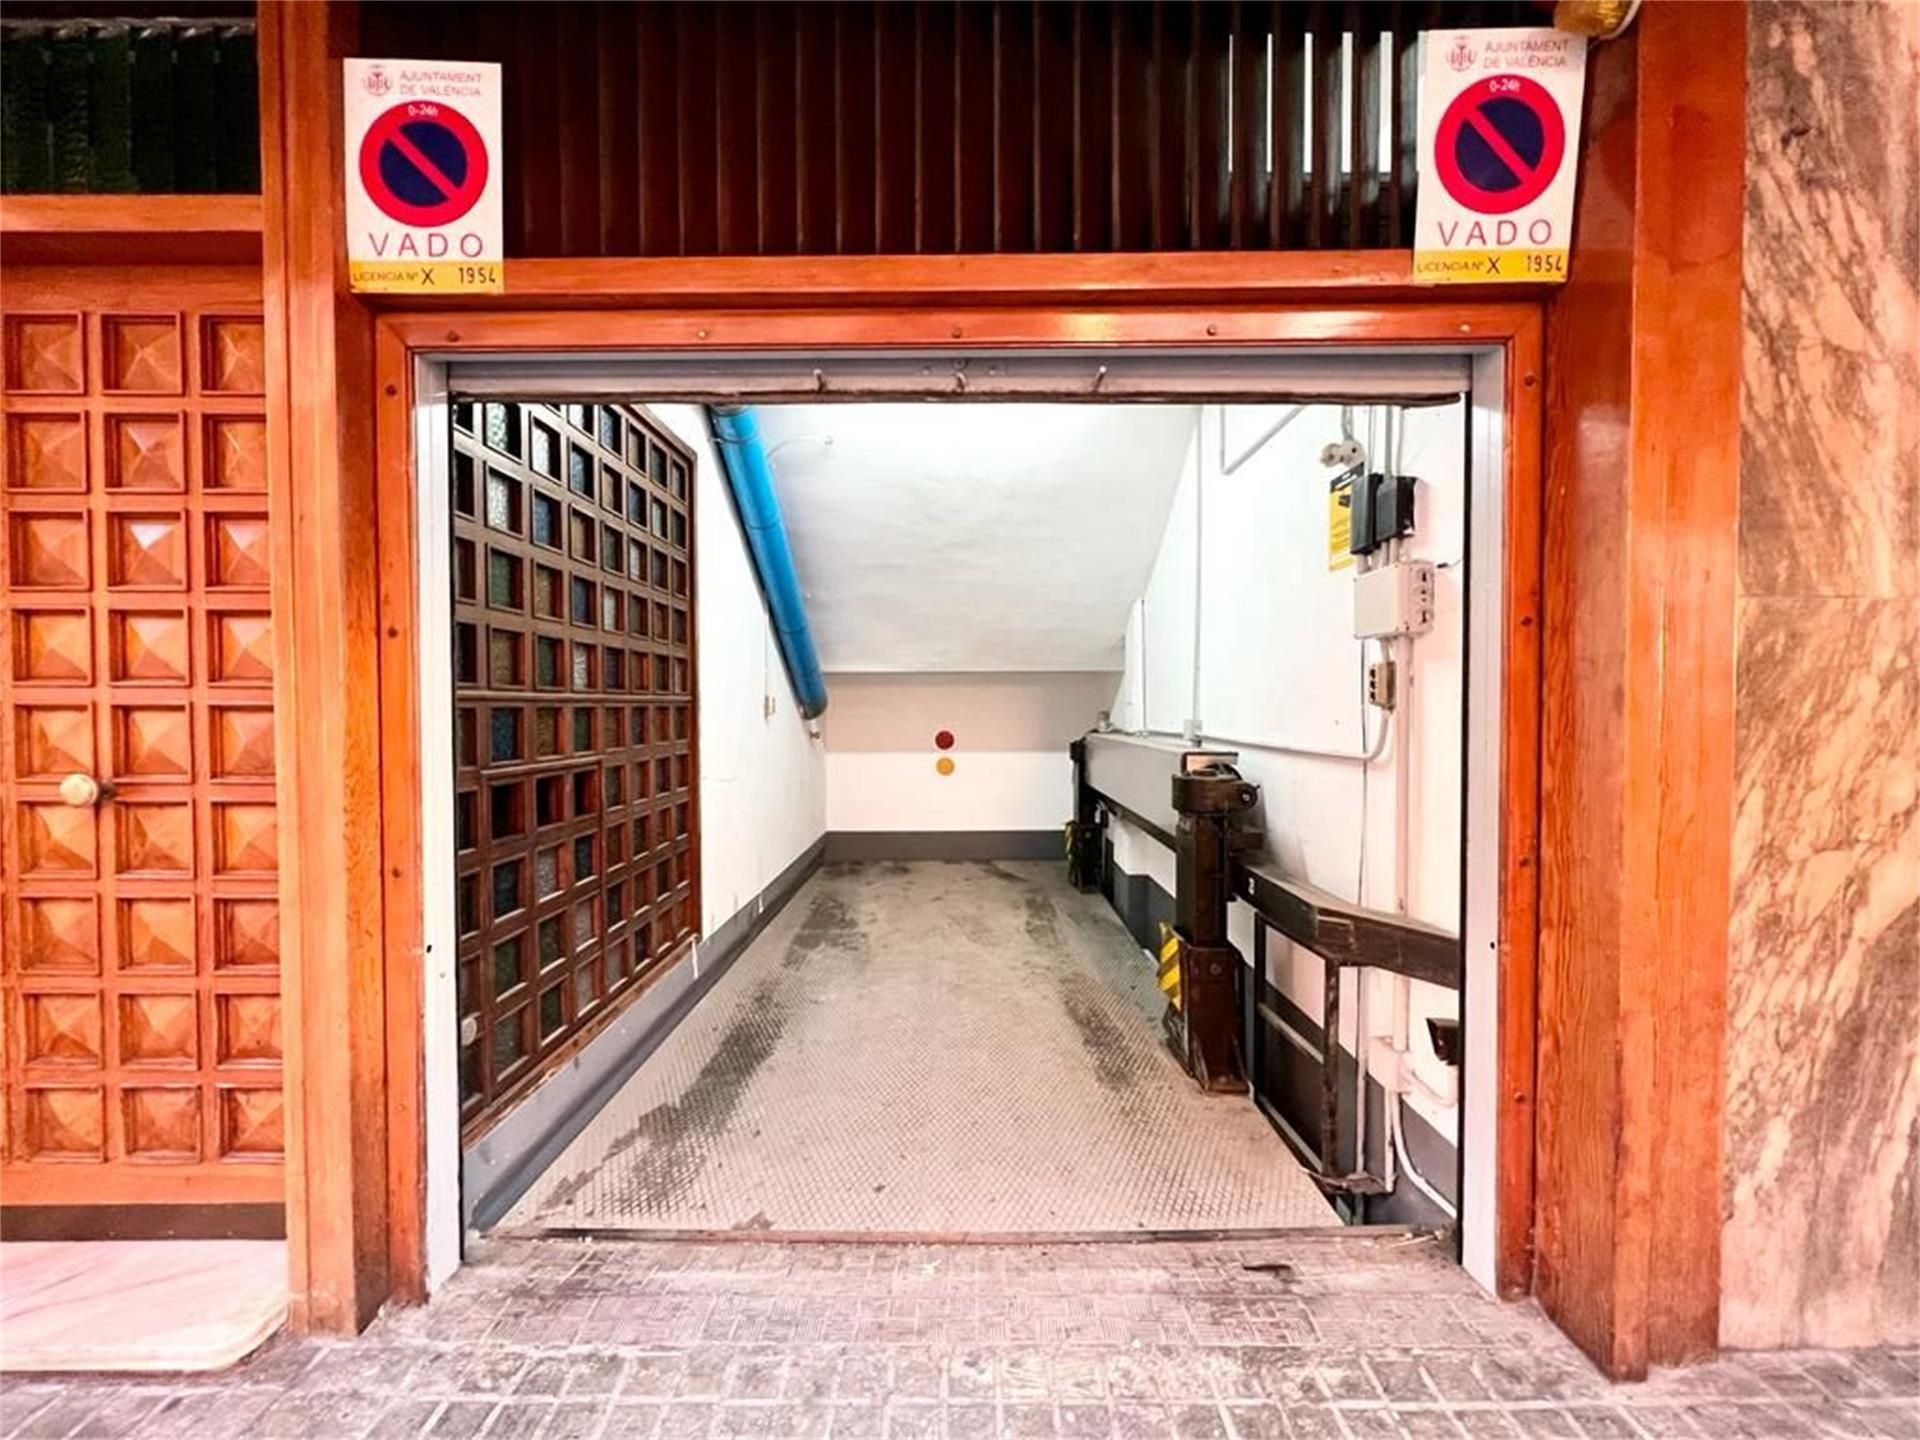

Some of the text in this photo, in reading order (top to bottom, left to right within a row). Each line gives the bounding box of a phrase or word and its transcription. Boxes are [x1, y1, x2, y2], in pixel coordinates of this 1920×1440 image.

[1485, 39, 1569, 52] AJUNTAMENT
[1484, 57, 1500, 68] DE
[400, 70, 481, 83] AJUNTAMENT
[400, 84, 417, 95] DE
[407, 105, 439, 117] 0-24h
[1437, 219, 1552, 247] VADO
[368, 232, 484, 258] VADO
[1416, 262, 1470, 273] LICENCIA
[1486, 257, 1501, 274] X
[1527, 254, 1563, 272] 1954
[353, 271, 405, 282] LICENCIA
[421, 267, 435, 286] X
[458, 267, 496, 284] 1954
